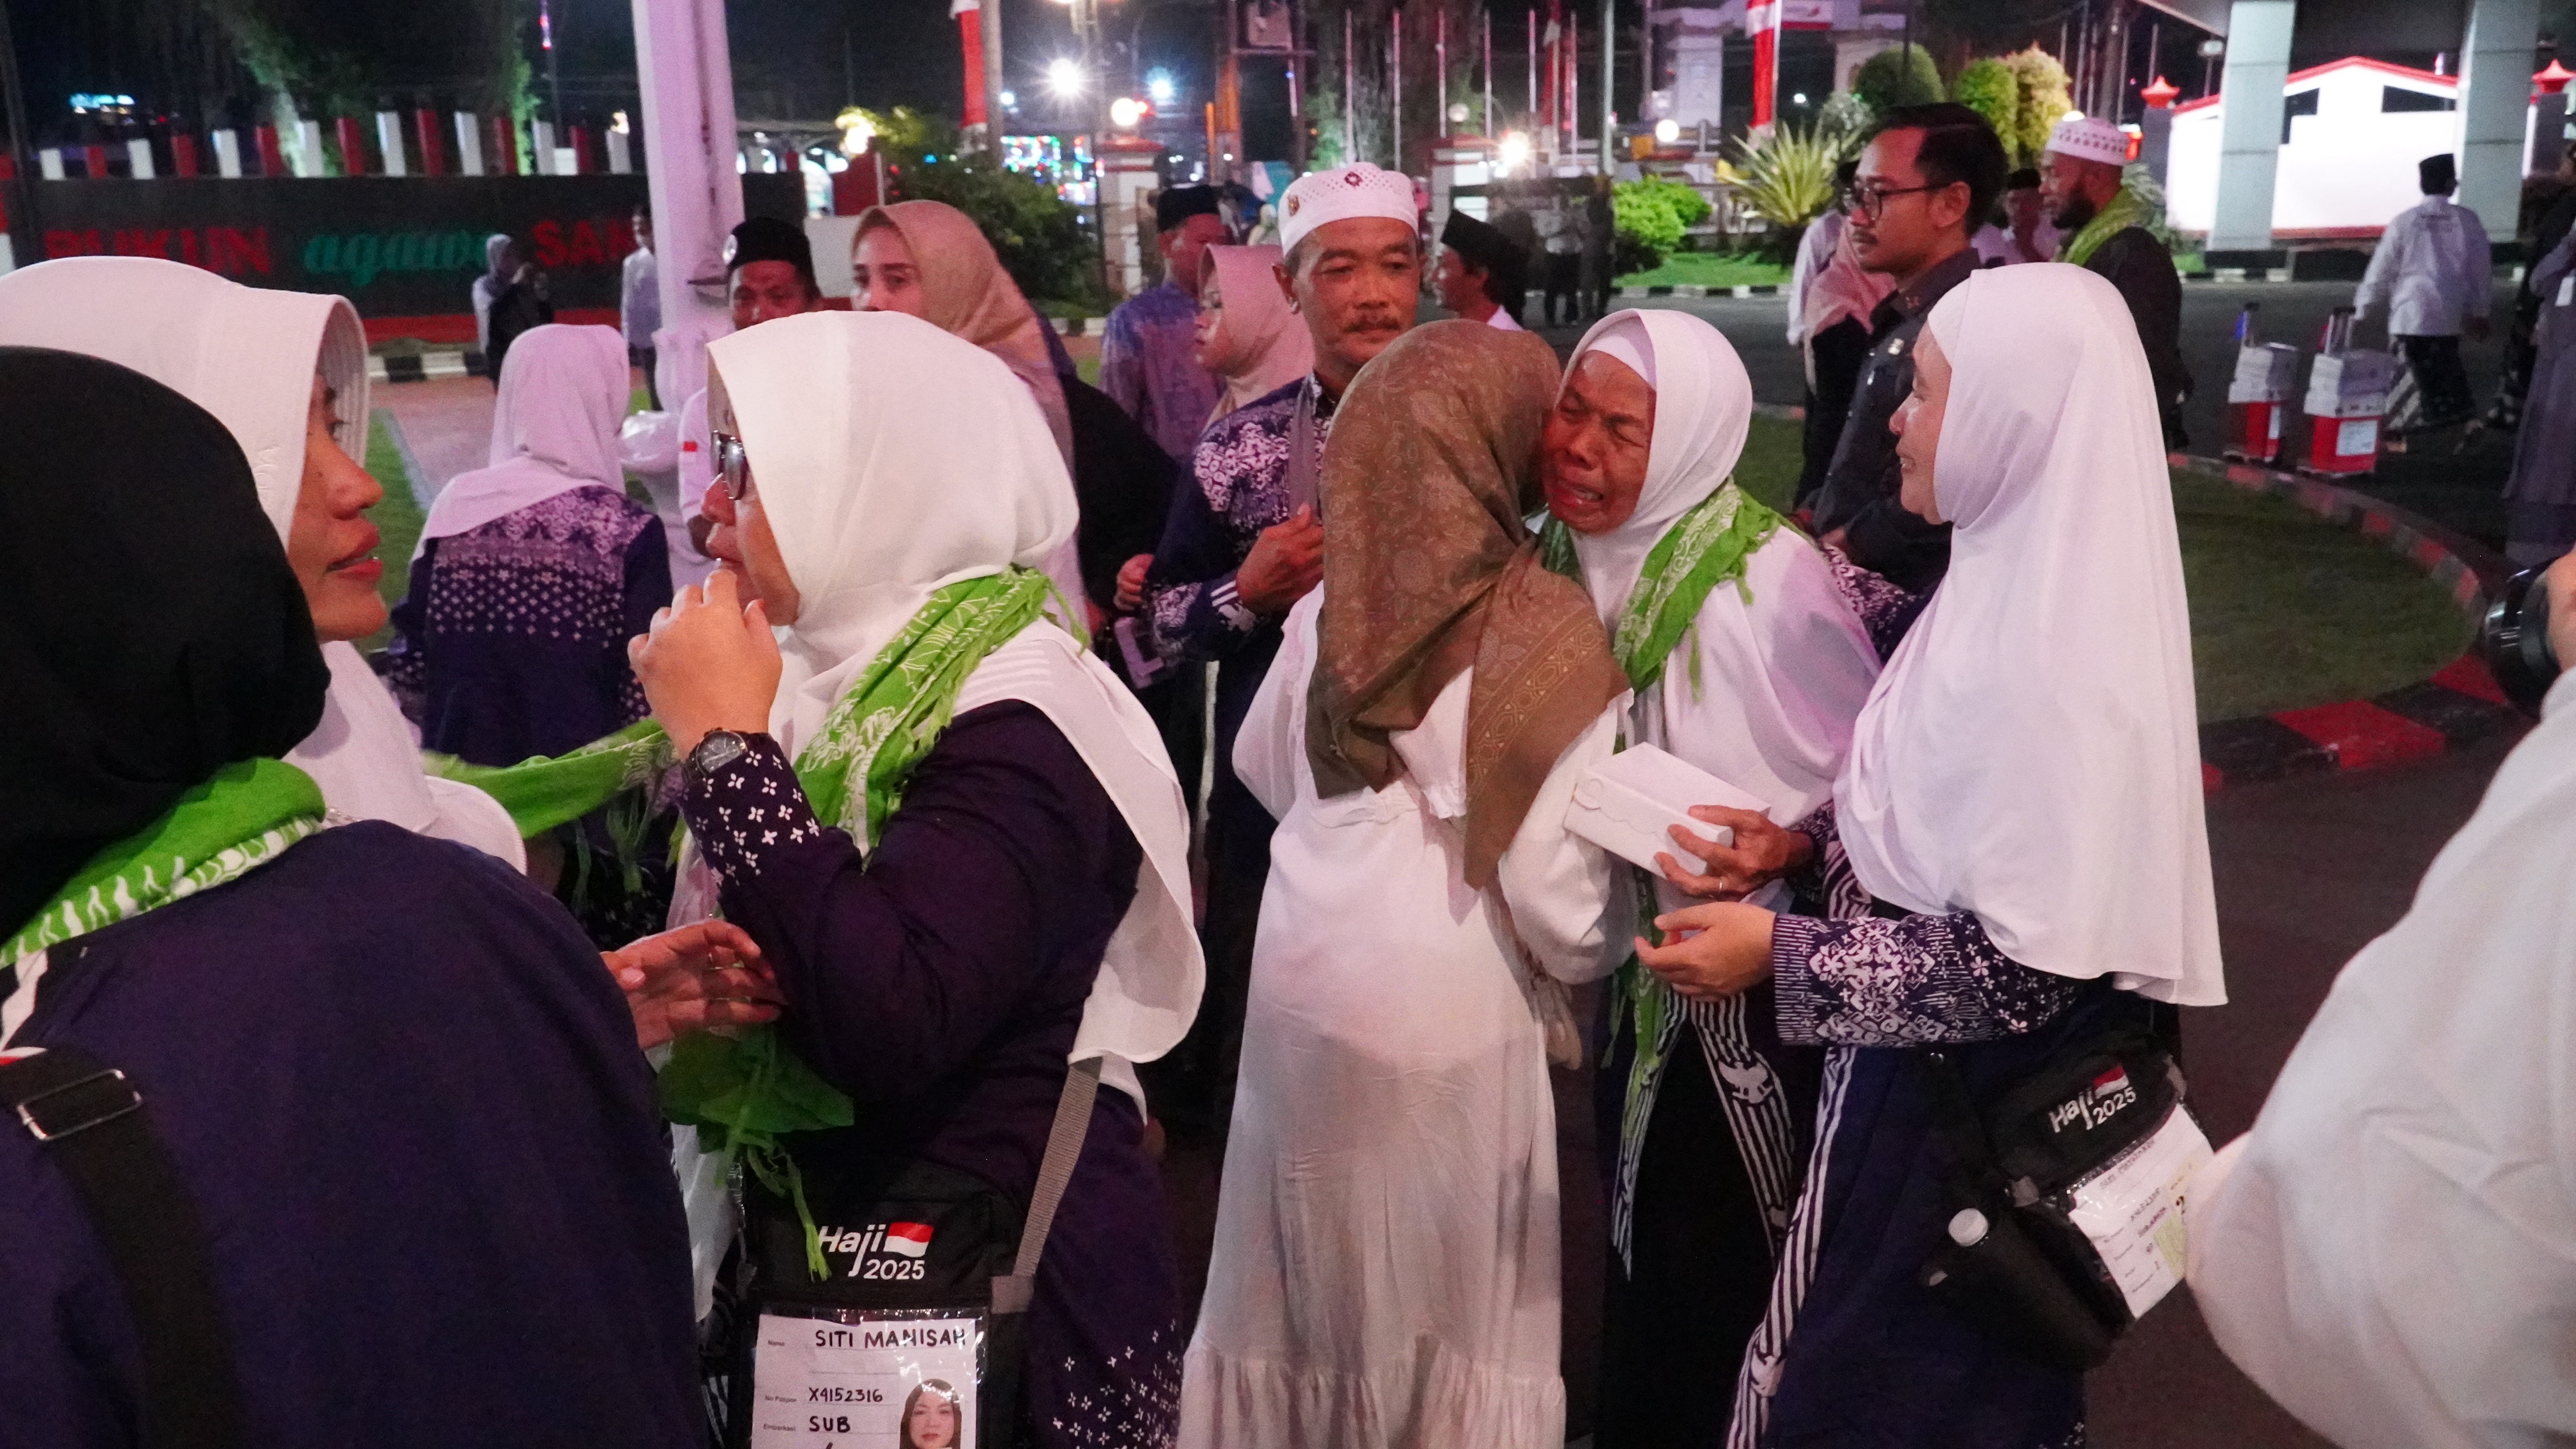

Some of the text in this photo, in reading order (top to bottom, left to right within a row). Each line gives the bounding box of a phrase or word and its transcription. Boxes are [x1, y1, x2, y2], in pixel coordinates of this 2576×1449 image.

[2048, 1086, 2093, 1133] Haji
[2093, 1087, 2136, 1125] 2025
[819, 1224, 886, 1277] Haji
[863, 1259, 925, 1280] 2025
[816, 1328, 966, 1349] SITI MANISAH
[809, 1416, 851, 1433] SUB
